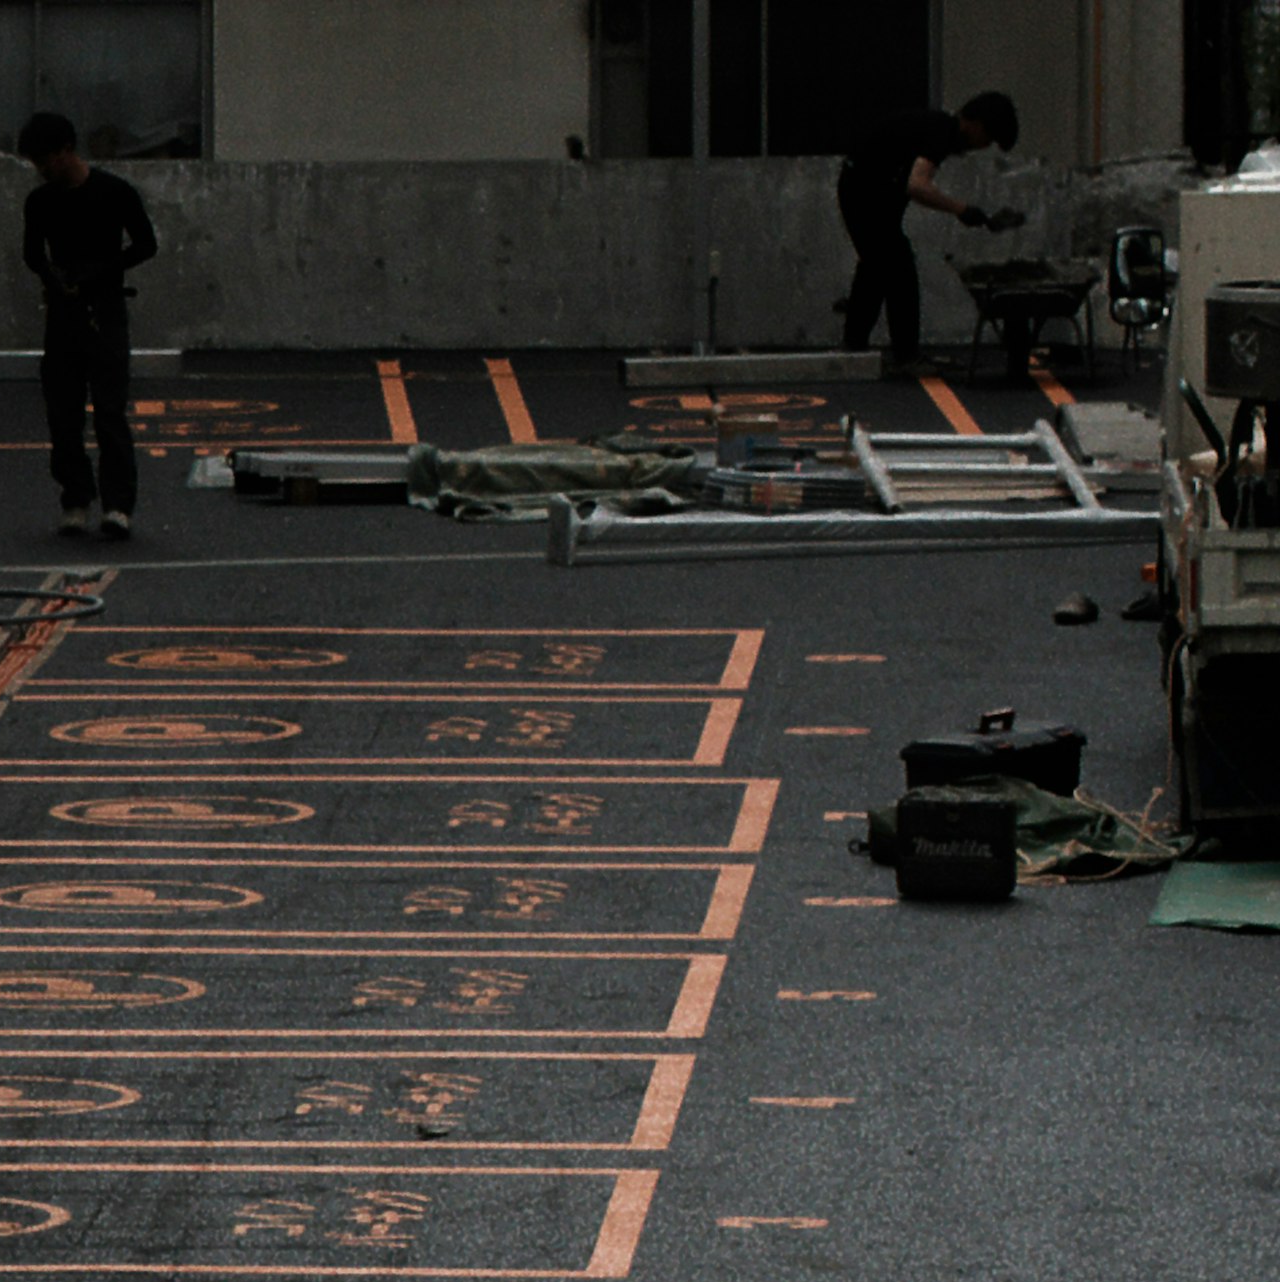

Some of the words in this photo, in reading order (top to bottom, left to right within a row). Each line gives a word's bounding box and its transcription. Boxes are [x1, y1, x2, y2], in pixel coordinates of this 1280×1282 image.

[775, 987, 878, 1002] 5
[749, 1094, 857, 1110] 4
[714, 1214, 831, 1231] 3
